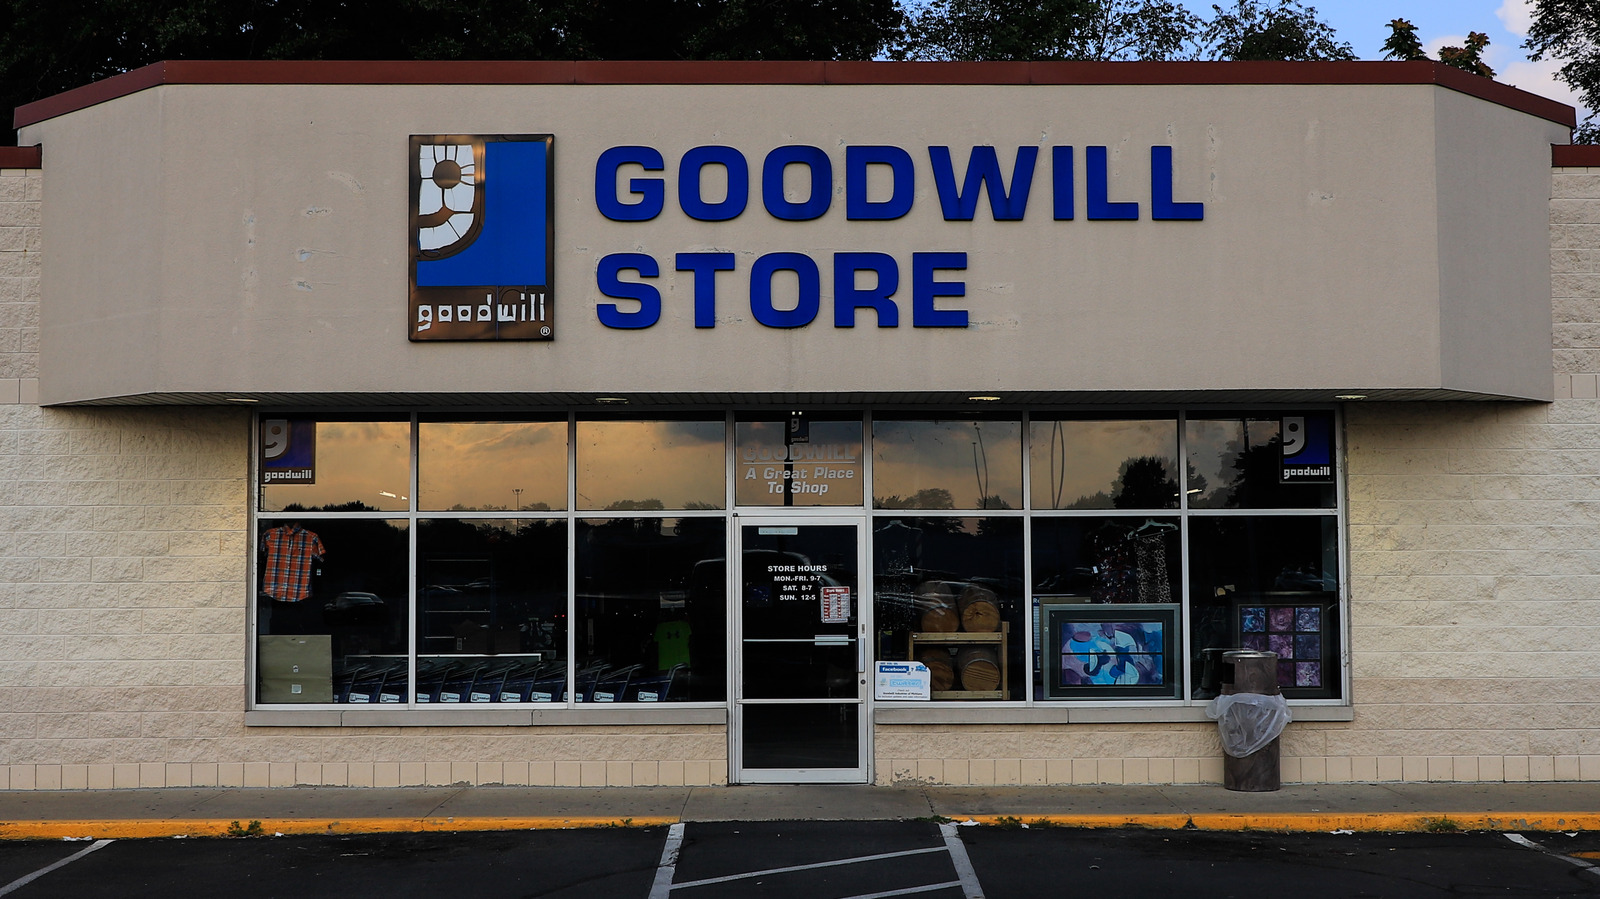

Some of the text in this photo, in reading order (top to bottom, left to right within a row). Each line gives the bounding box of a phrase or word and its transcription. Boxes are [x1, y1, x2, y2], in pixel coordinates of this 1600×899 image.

[594, 145, 1204, 222] GOODWILL
[596, 252, 969, 329] STORE
[417, 293, 546, 332] goodwill
[743, 444, 856, 461] GOODWILL
[264, 469, 312, 483] goodwill
[745, 466, 854, 480] A Great Place
[1283, 466, 1330, 480] goodwill
[767, 481, 829, 496] To Shop
